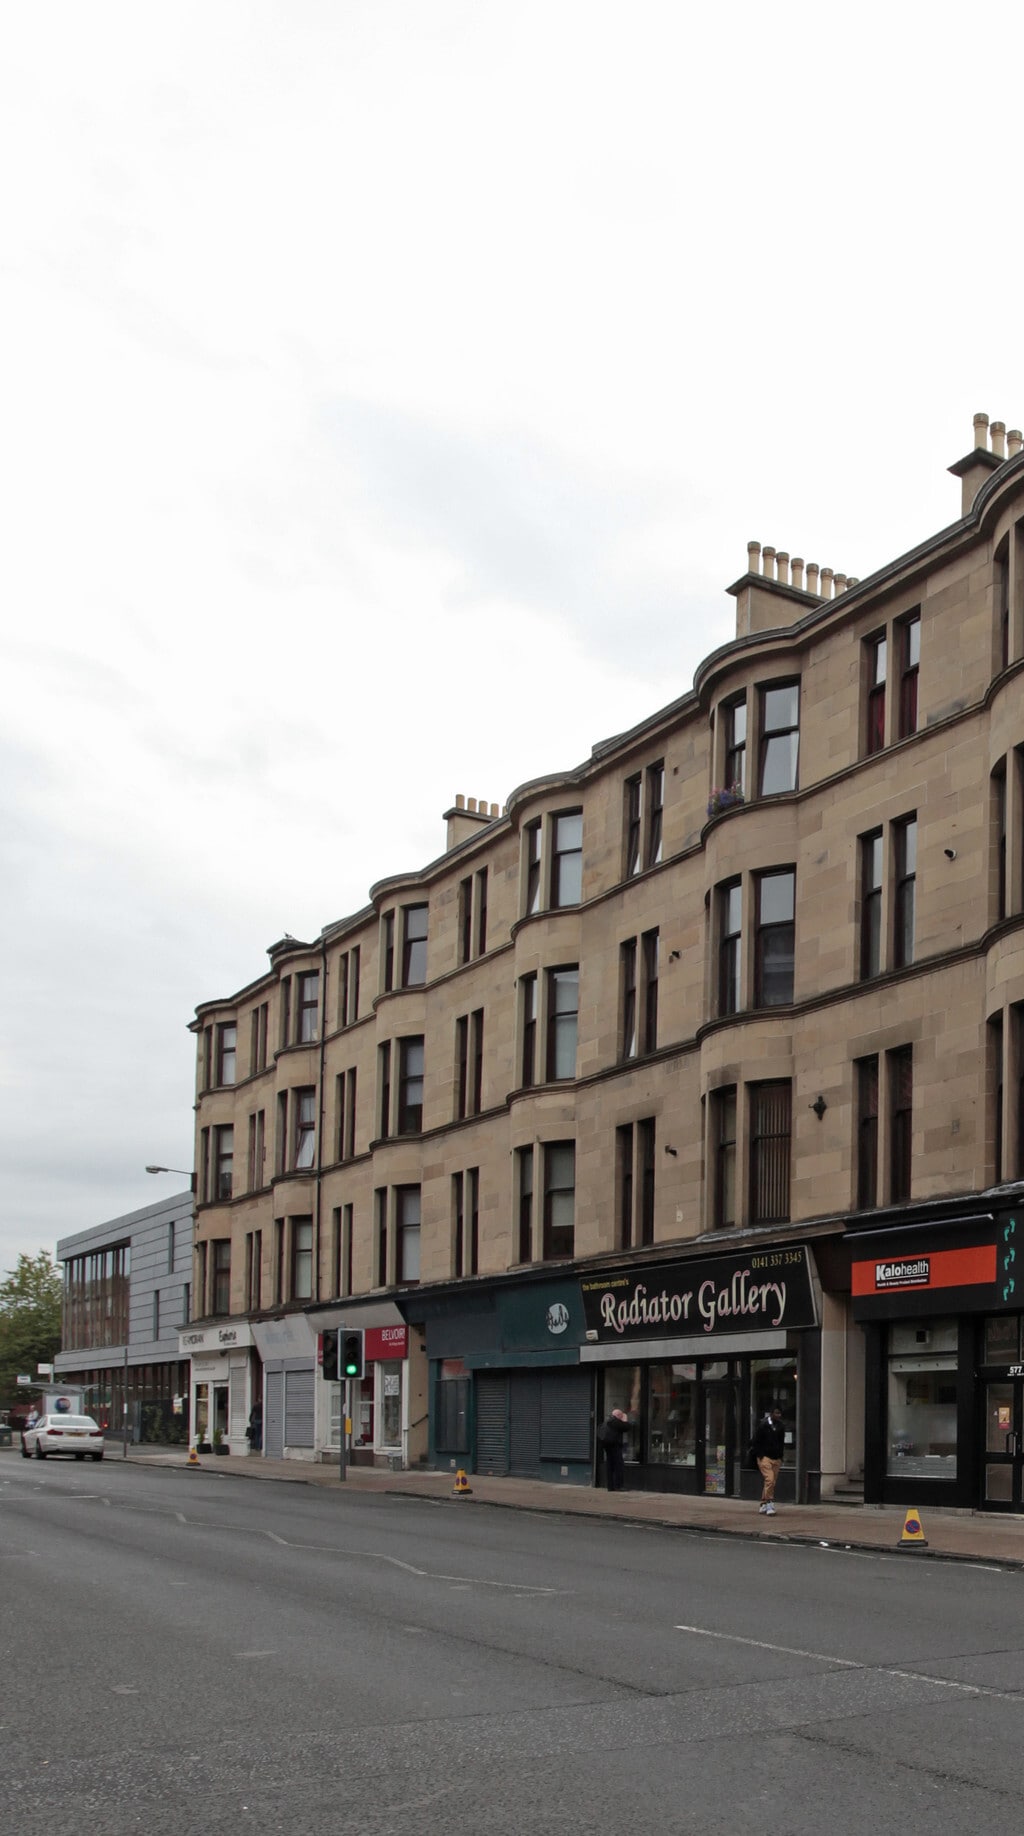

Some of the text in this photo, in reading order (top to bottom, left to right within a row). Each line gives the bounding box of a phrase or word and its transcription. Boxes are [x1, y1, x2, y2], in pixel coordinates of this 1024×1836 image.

[752, 1256, 768, 1268] 0141
[876, 1260, 929, 1281] Kalohealth
[600, 1284, 693, 1333] Radiator
[698, 1270, 786, 1332] Gallery
